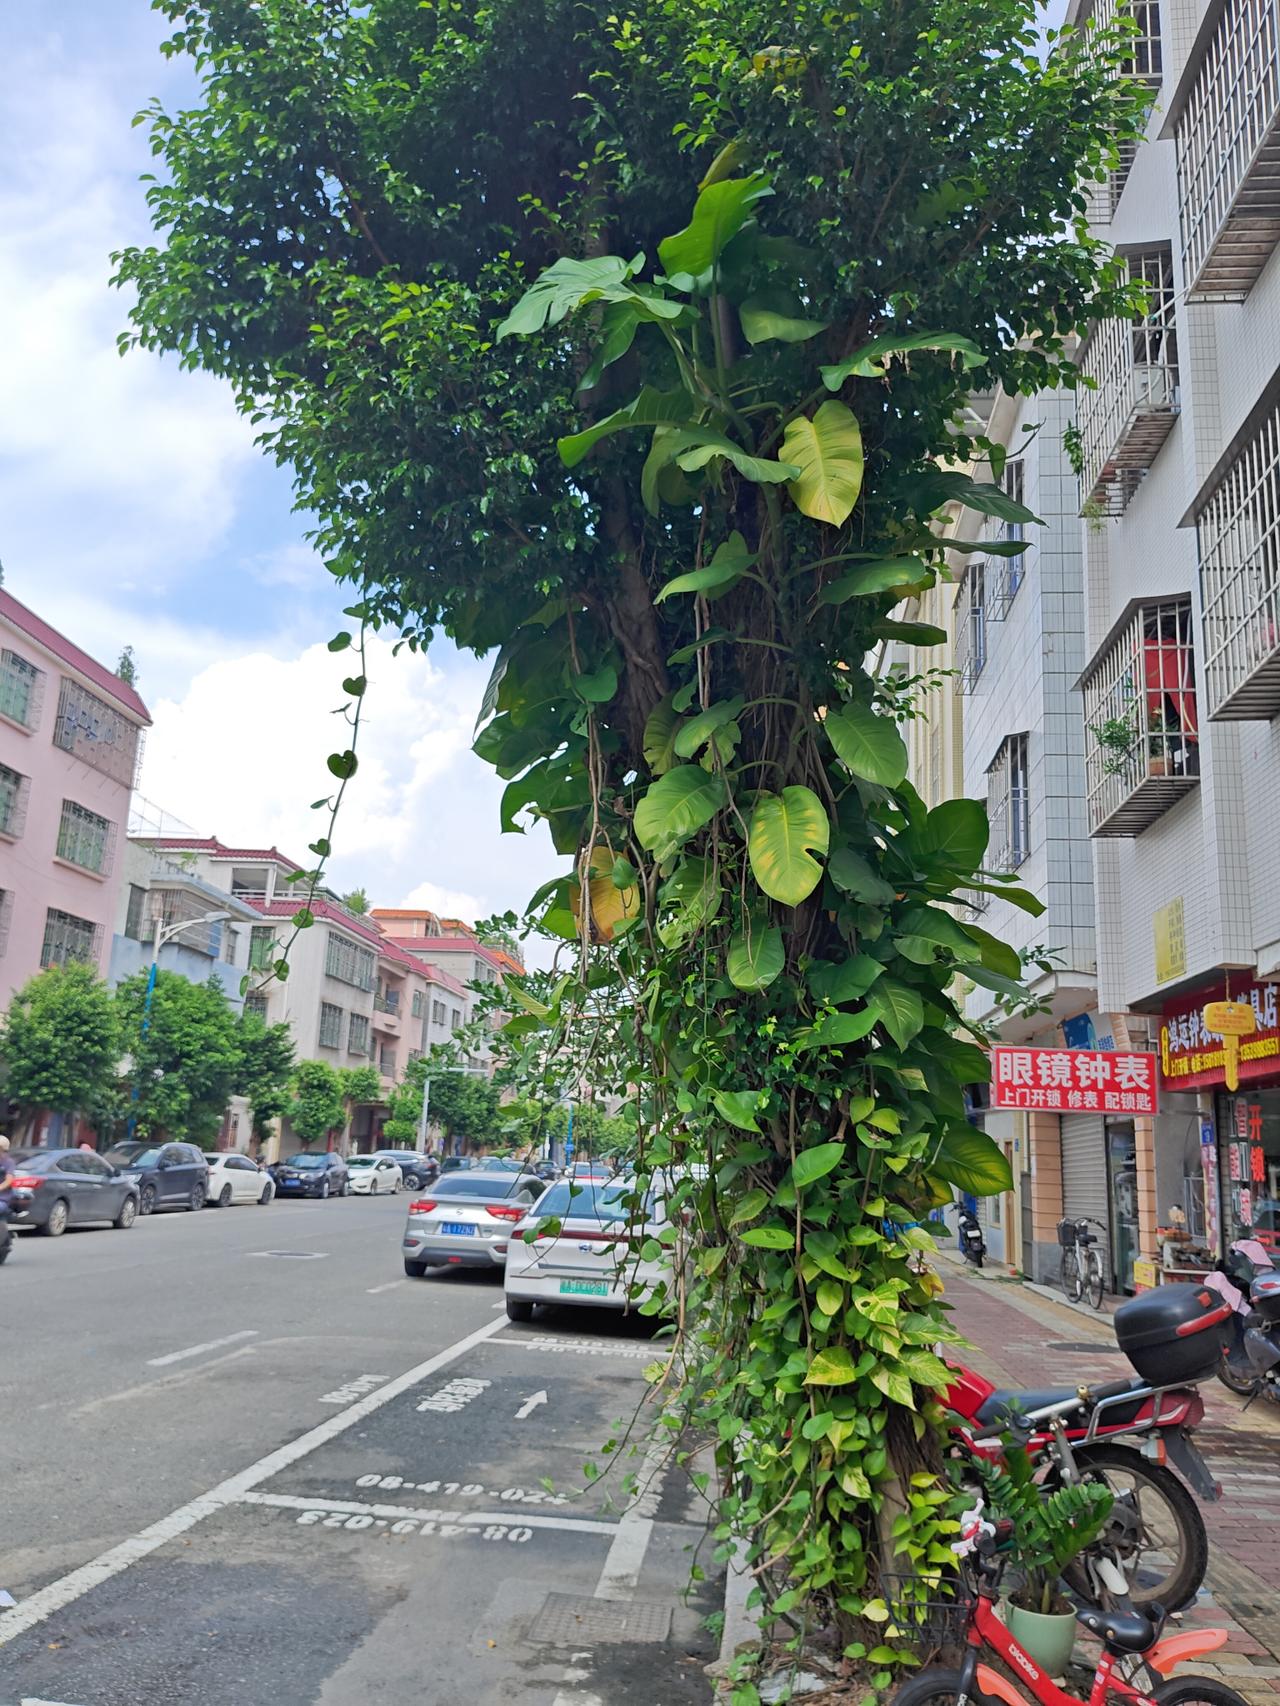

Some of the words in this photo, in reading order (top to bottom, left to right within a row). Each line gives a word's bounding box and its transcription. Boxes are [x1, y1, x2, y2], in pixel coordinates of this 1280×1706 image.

[998, 1052, 1150, 1090] 眼镜钟表
[1000, 1087, 1061, 1107] 上门开锁
[1067, 1090, 1098, 1109] 修表
[1104, 1091, 1152, 1111] 配锁匙
[295, 1510, 533, 1543] 08-419-023
